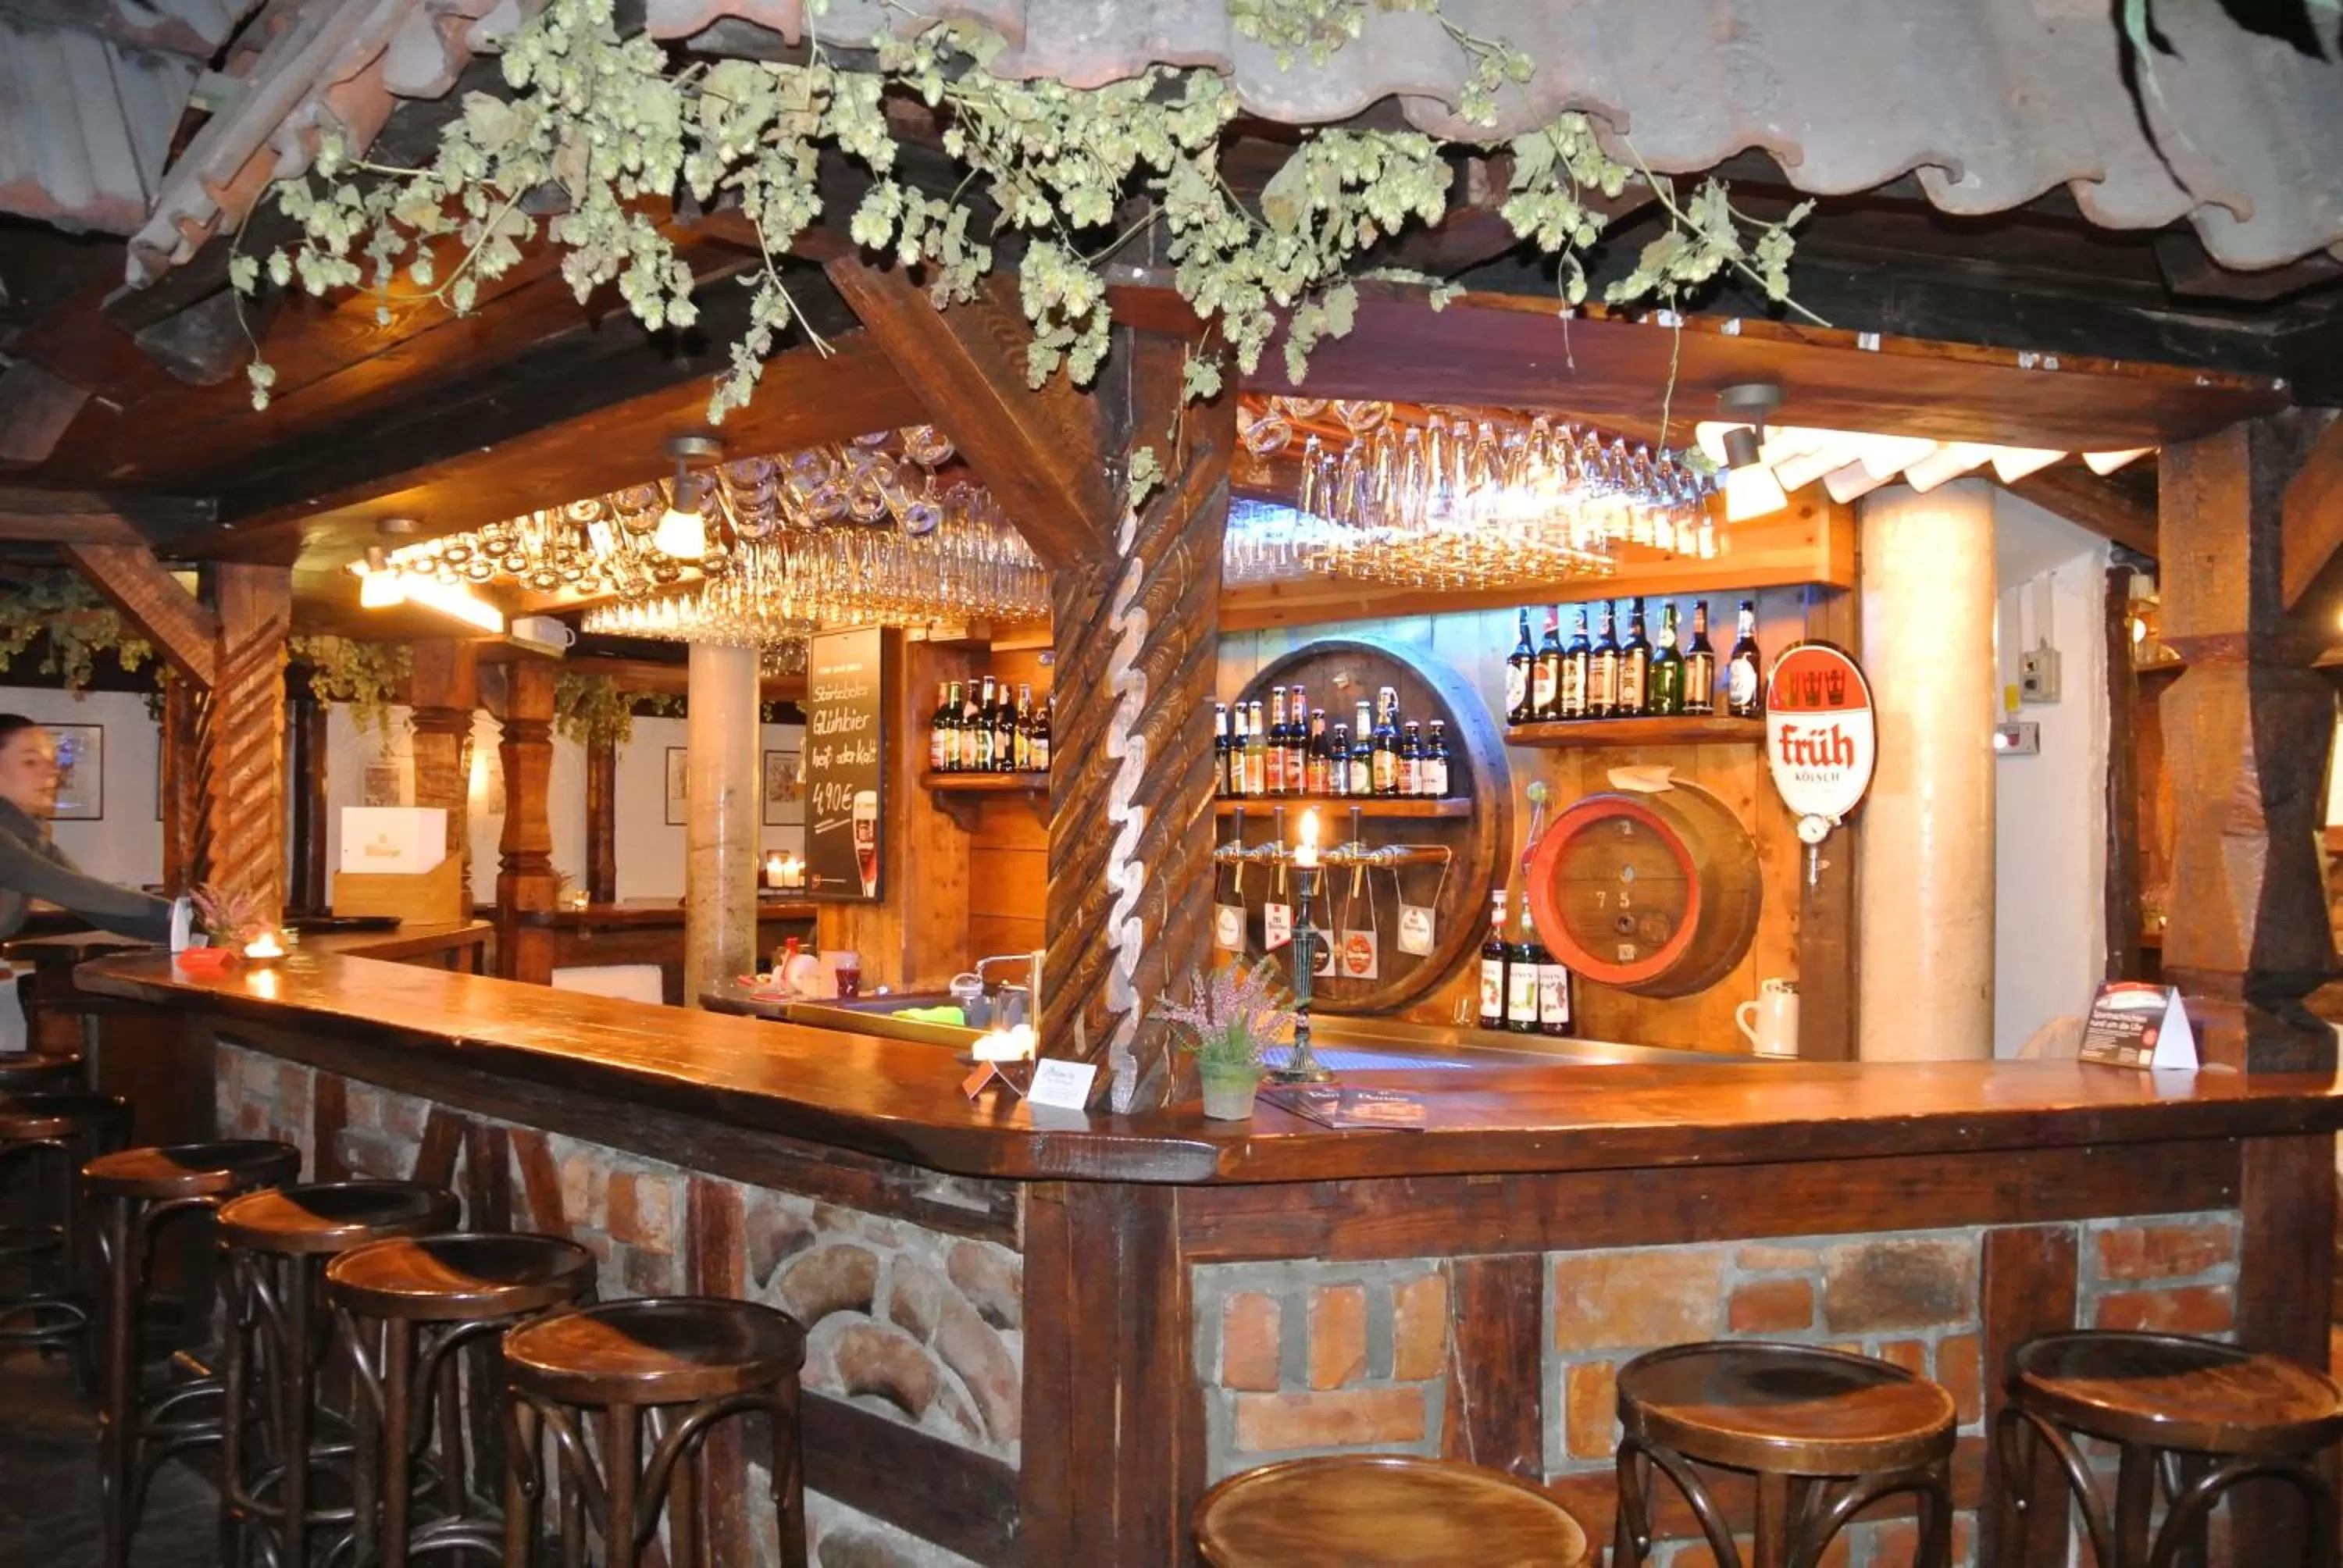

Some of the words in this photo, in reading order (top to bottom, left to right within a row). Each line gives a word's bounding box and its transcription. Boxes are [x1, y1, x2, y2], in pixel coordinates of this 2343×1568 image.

[813, 707, 871, 735] Glühbier
[1779, 723, 1854, 769] früh
[1795, 772, 1839, 782] KÖLSCH
